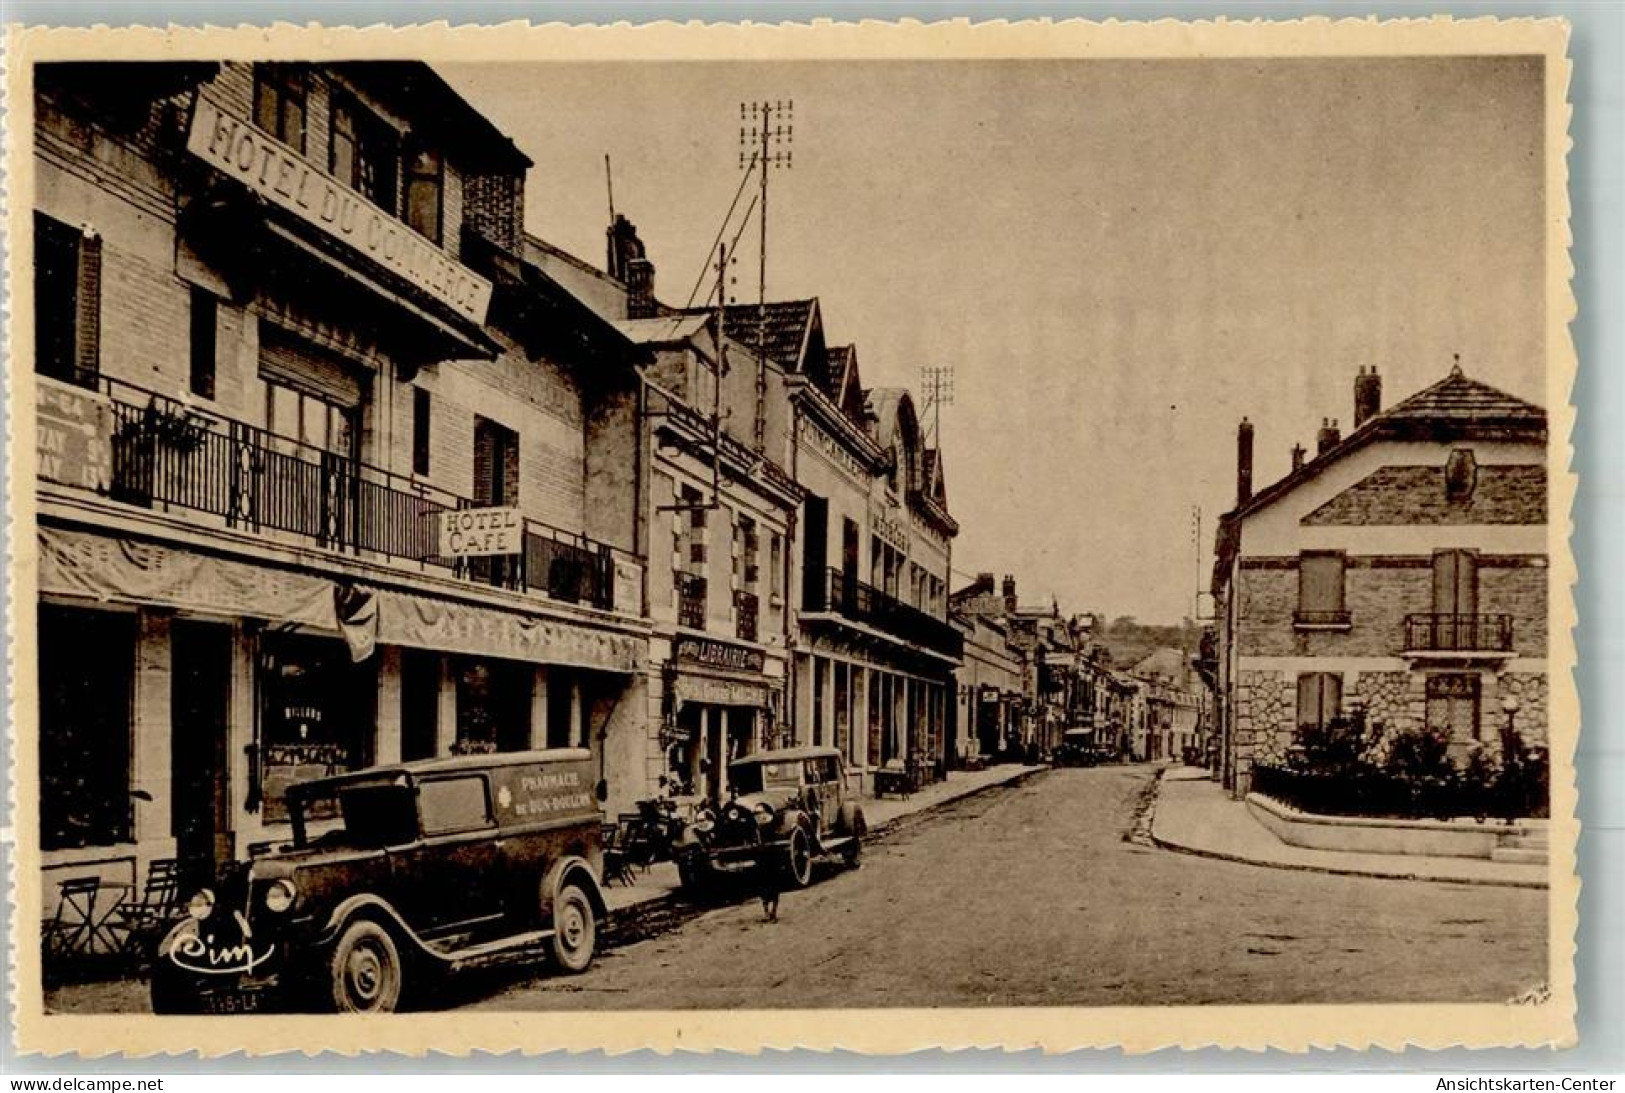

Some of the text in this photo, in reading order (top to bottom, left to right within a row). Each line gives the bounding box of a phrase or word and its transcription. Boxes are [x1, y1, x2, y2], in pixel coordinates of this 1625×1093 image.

[208, 111, 310, 209] HOTEL
[320, 184, 360, 234] DU
[447, 511, 516, 532] HOTEL
[699, 640, 749, 668] LIBRAIRIE
[521, 771, 580, 791] PHARMACIE
